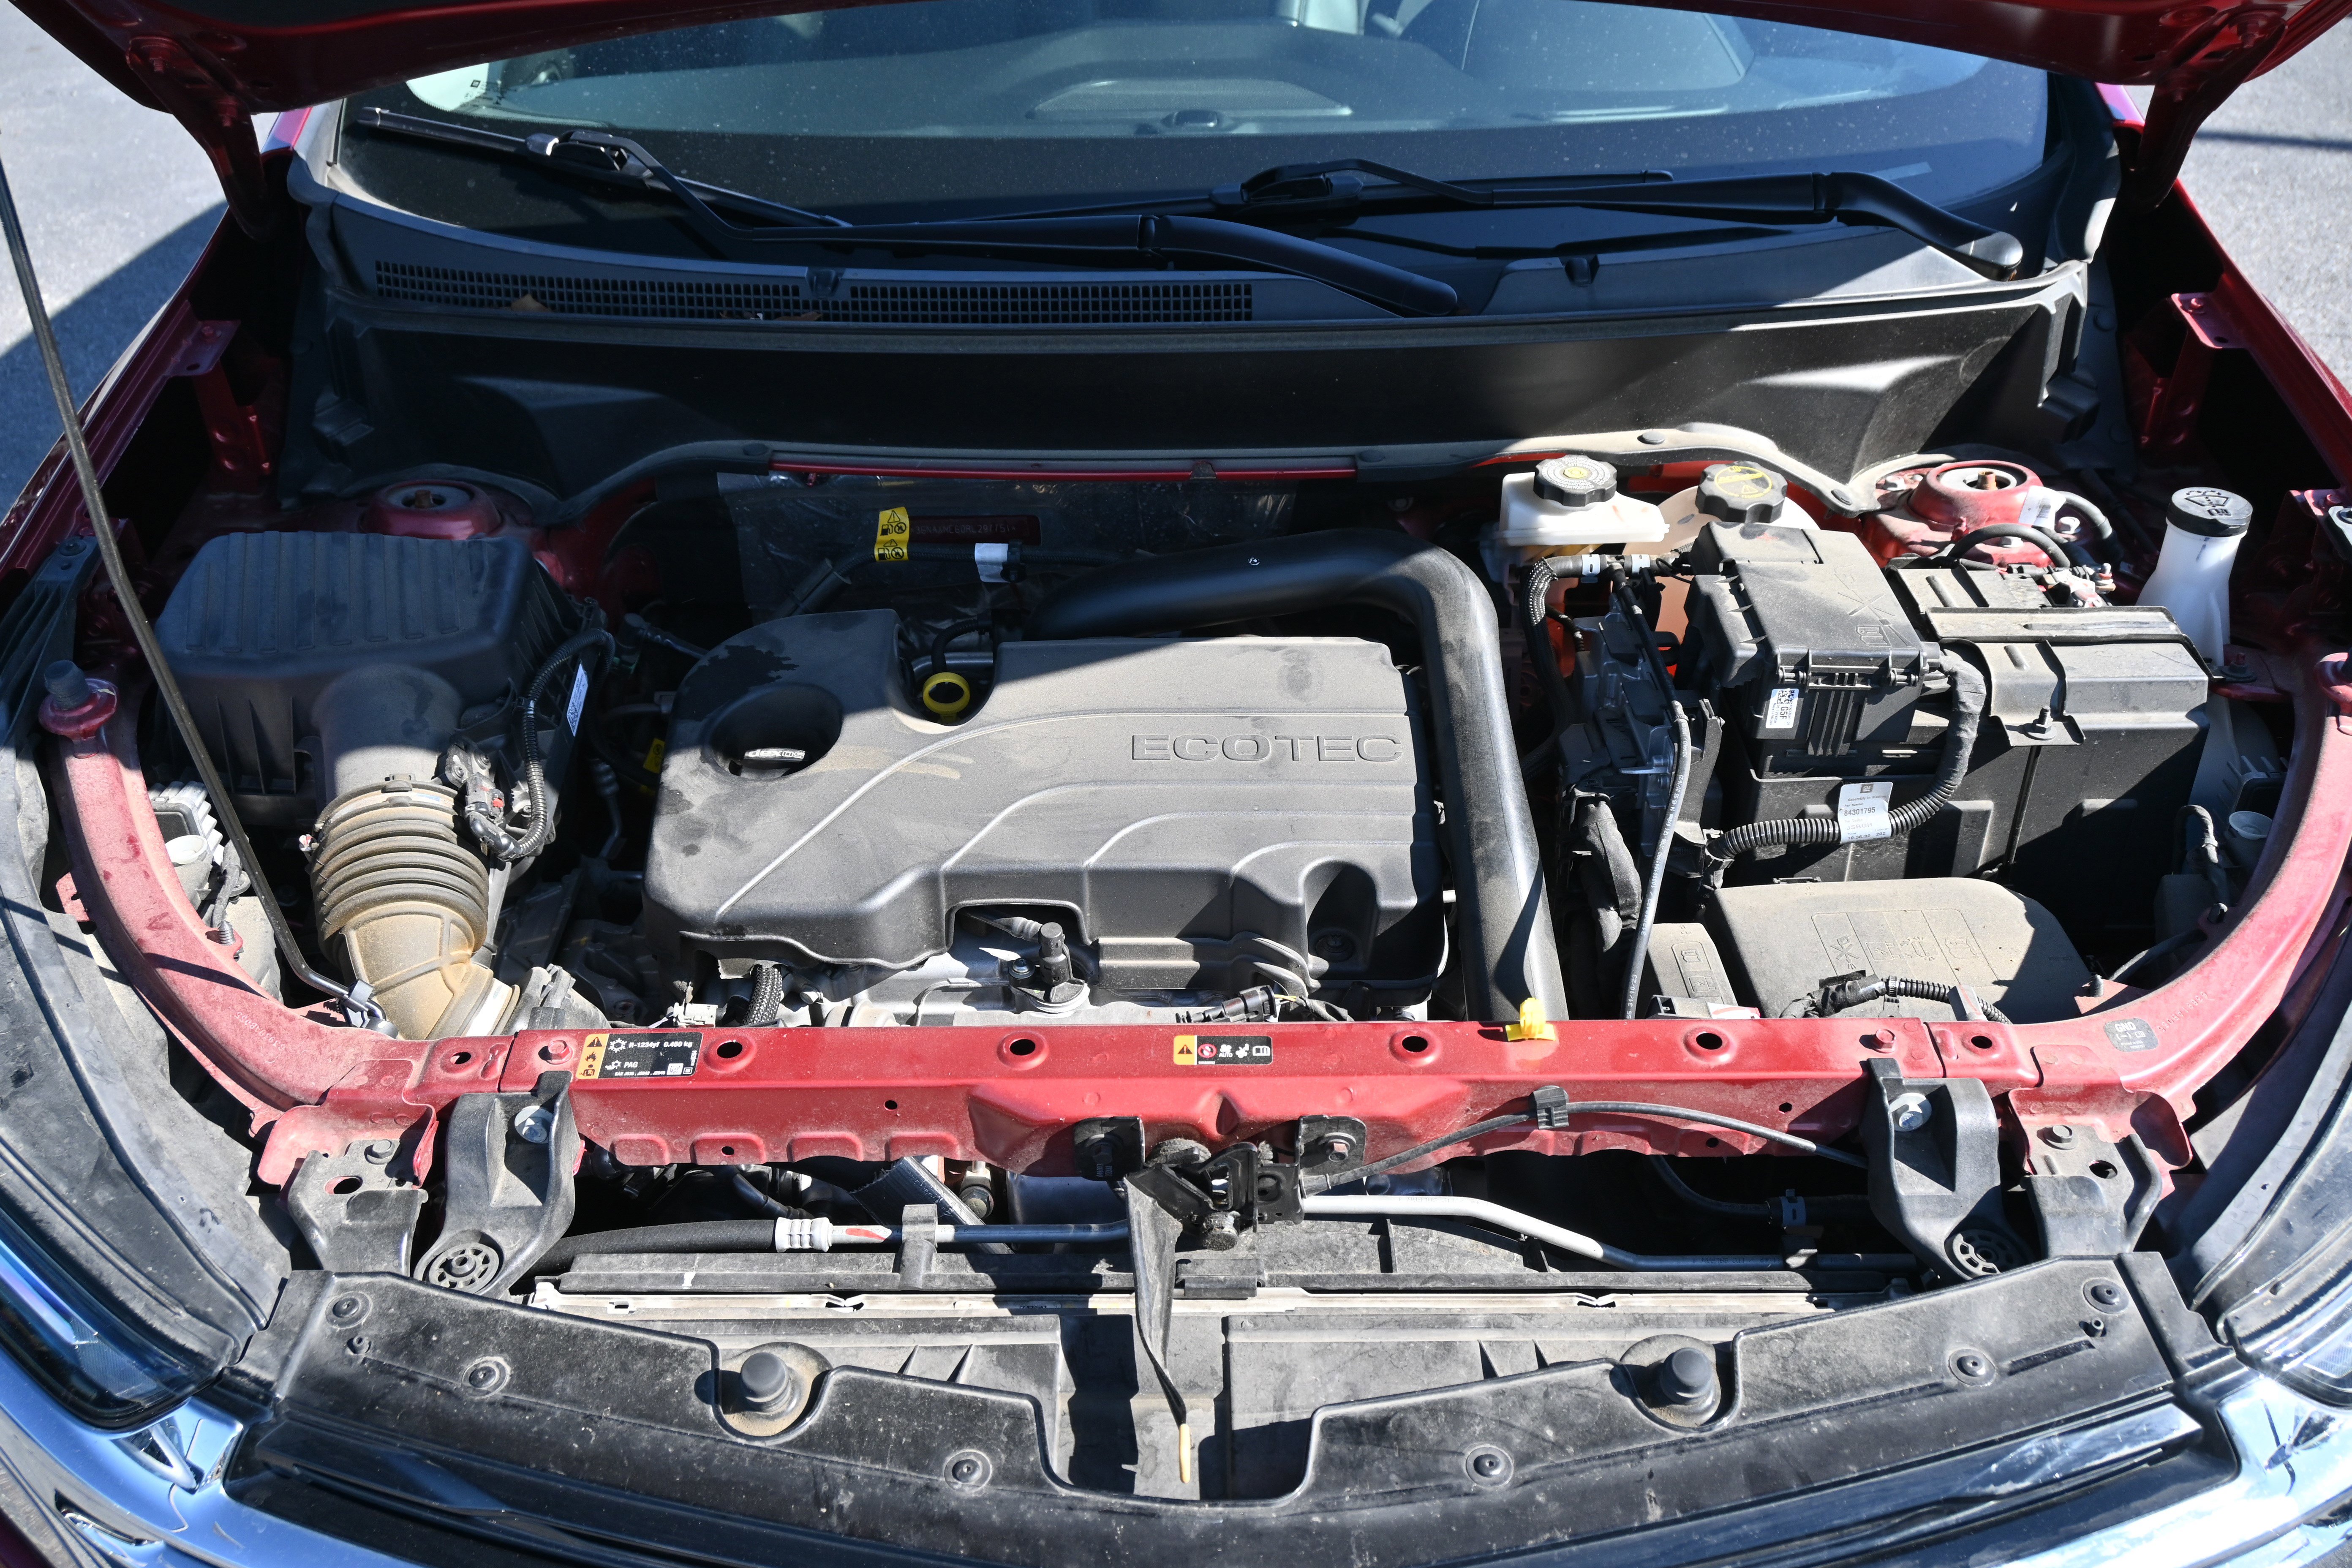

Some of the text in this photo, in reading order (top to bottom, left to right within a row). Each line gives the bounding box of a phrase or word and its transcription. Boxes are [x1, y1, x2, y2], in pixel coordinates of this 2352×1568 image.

[1780, 706, 1788, 719] G5F
[749, 749, 805, 759] dexos
[1132, 733, 1403, 762] ECOTEC
[1675, 775, 1684, 792] 31/10/23
[1844, 807, 1876, 816] 84301795
[1628, 975, 1638, 1007] 31/10/23
[2114, 1022, 2137, 1032] GND
